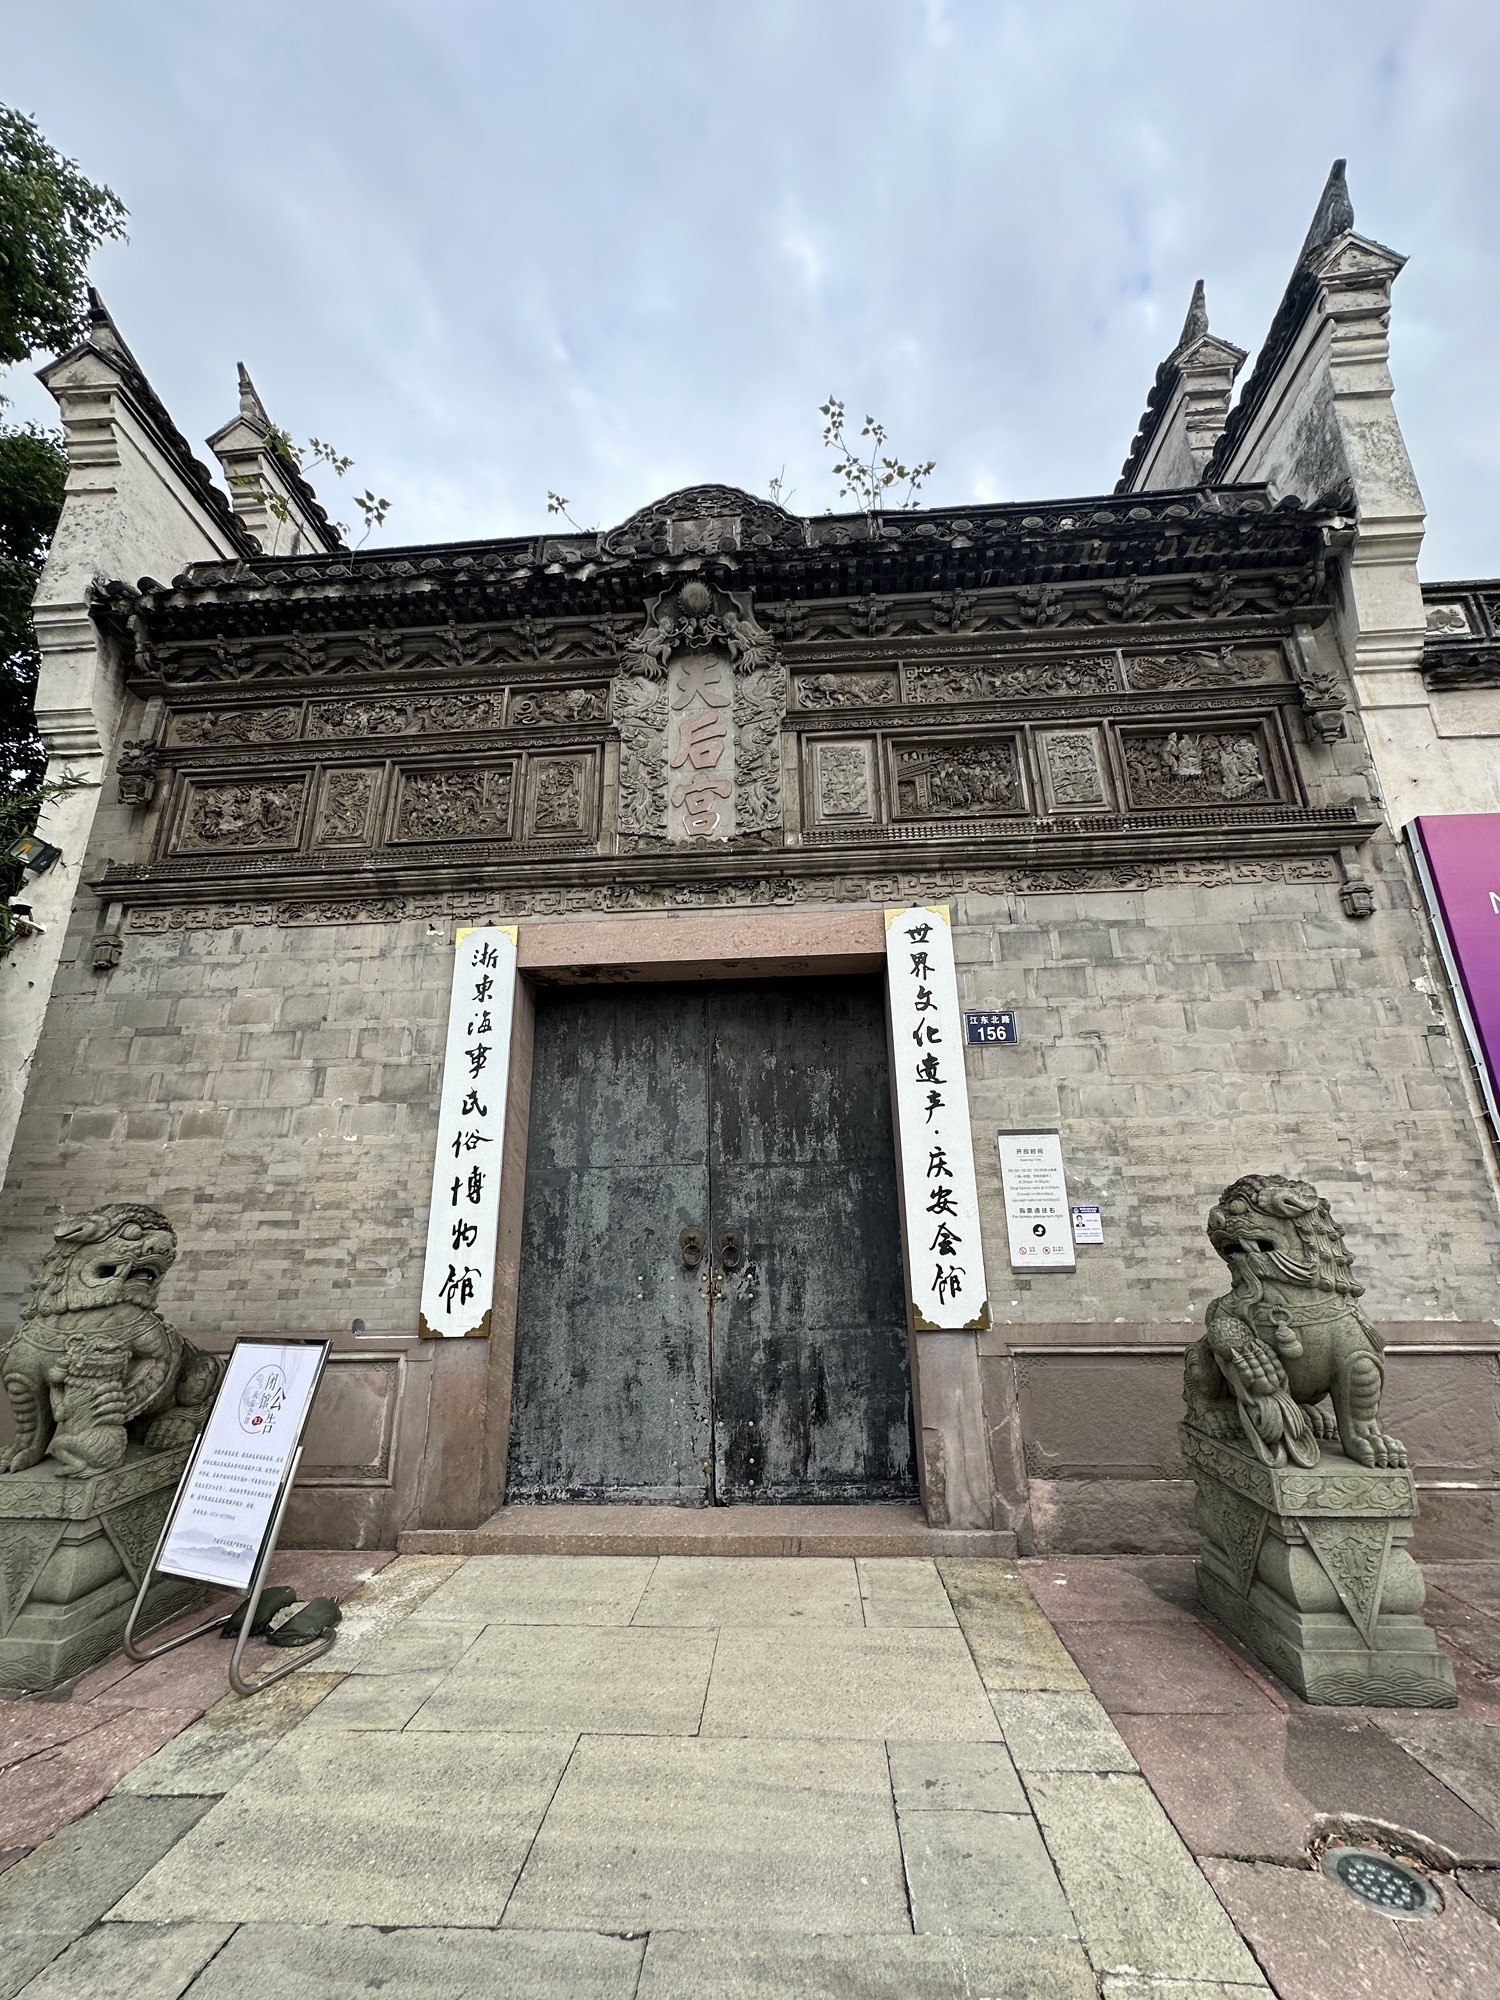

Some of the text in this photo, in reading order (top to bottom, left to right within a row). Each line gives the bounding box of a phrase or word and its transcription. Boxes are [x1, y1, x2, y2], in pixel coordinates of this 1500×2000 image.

[670, 651, 733, 836] 天后宫
[969, 1015, 1010, 1025] 江东北路
[978, 1026, 1006, 1040] 156
[259, 1372, 279, 1410] 闭馆
[262, 1387, 287, 1434] 公告
